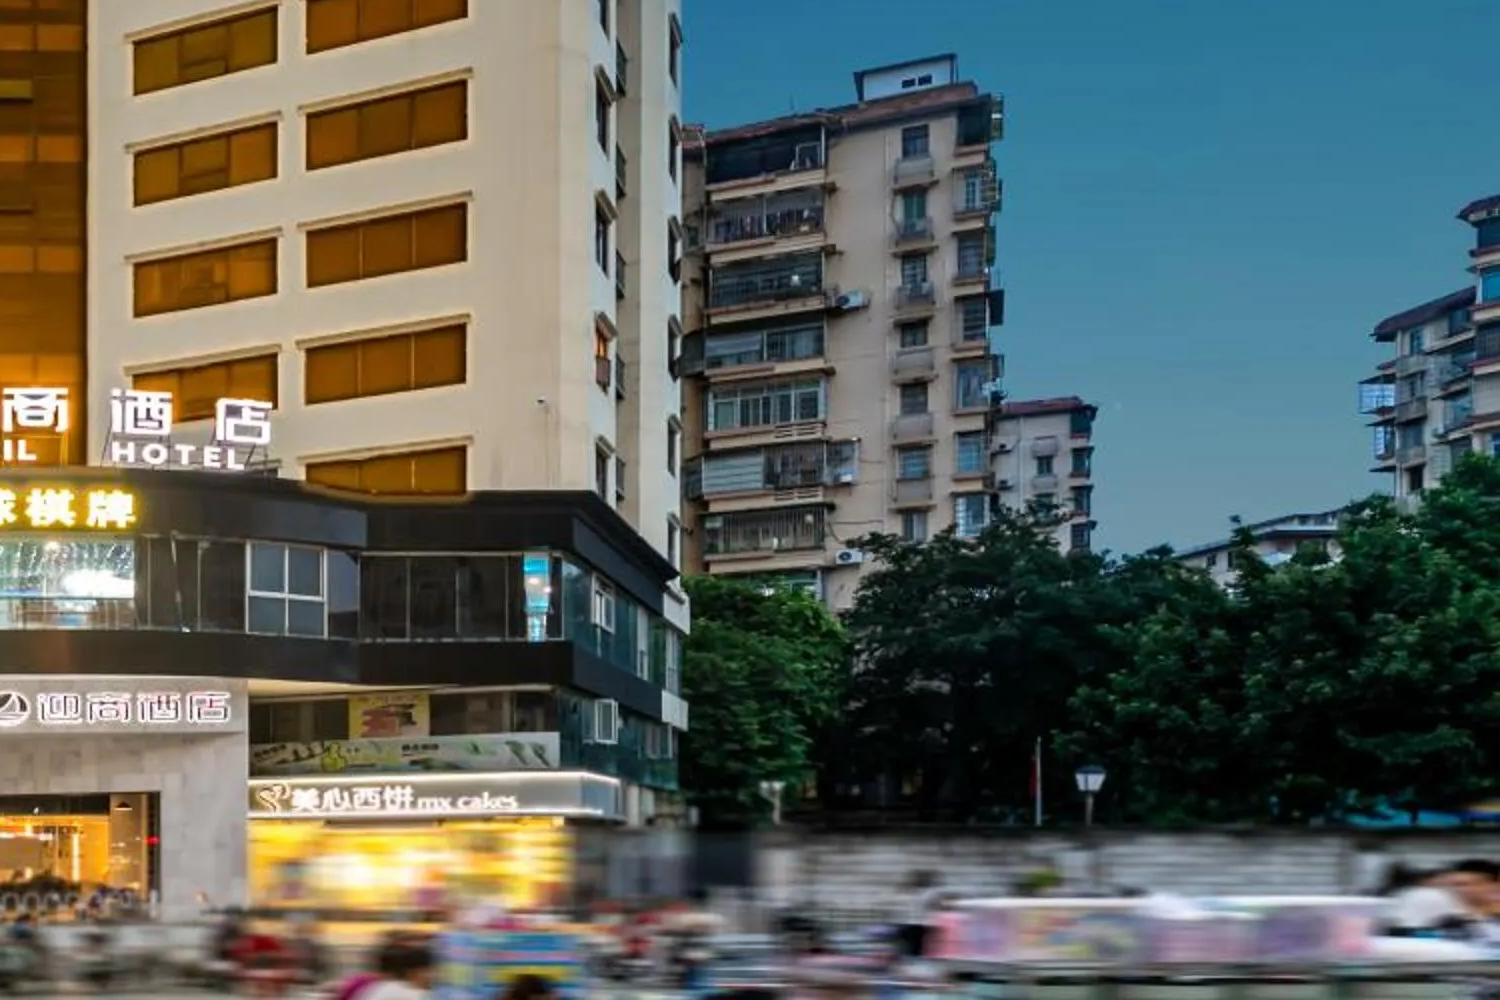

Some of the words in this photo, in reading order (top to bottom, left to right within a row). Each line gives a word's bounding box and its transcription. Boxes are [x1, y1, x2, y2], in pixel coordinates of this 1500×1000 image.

[111, 442, 246, 471] HOTEL
[37, 690, 232, 725] 迎商酒店
[291, 785, 415, 813] 美心西饼
[457, 792, 518, 811] cakes
